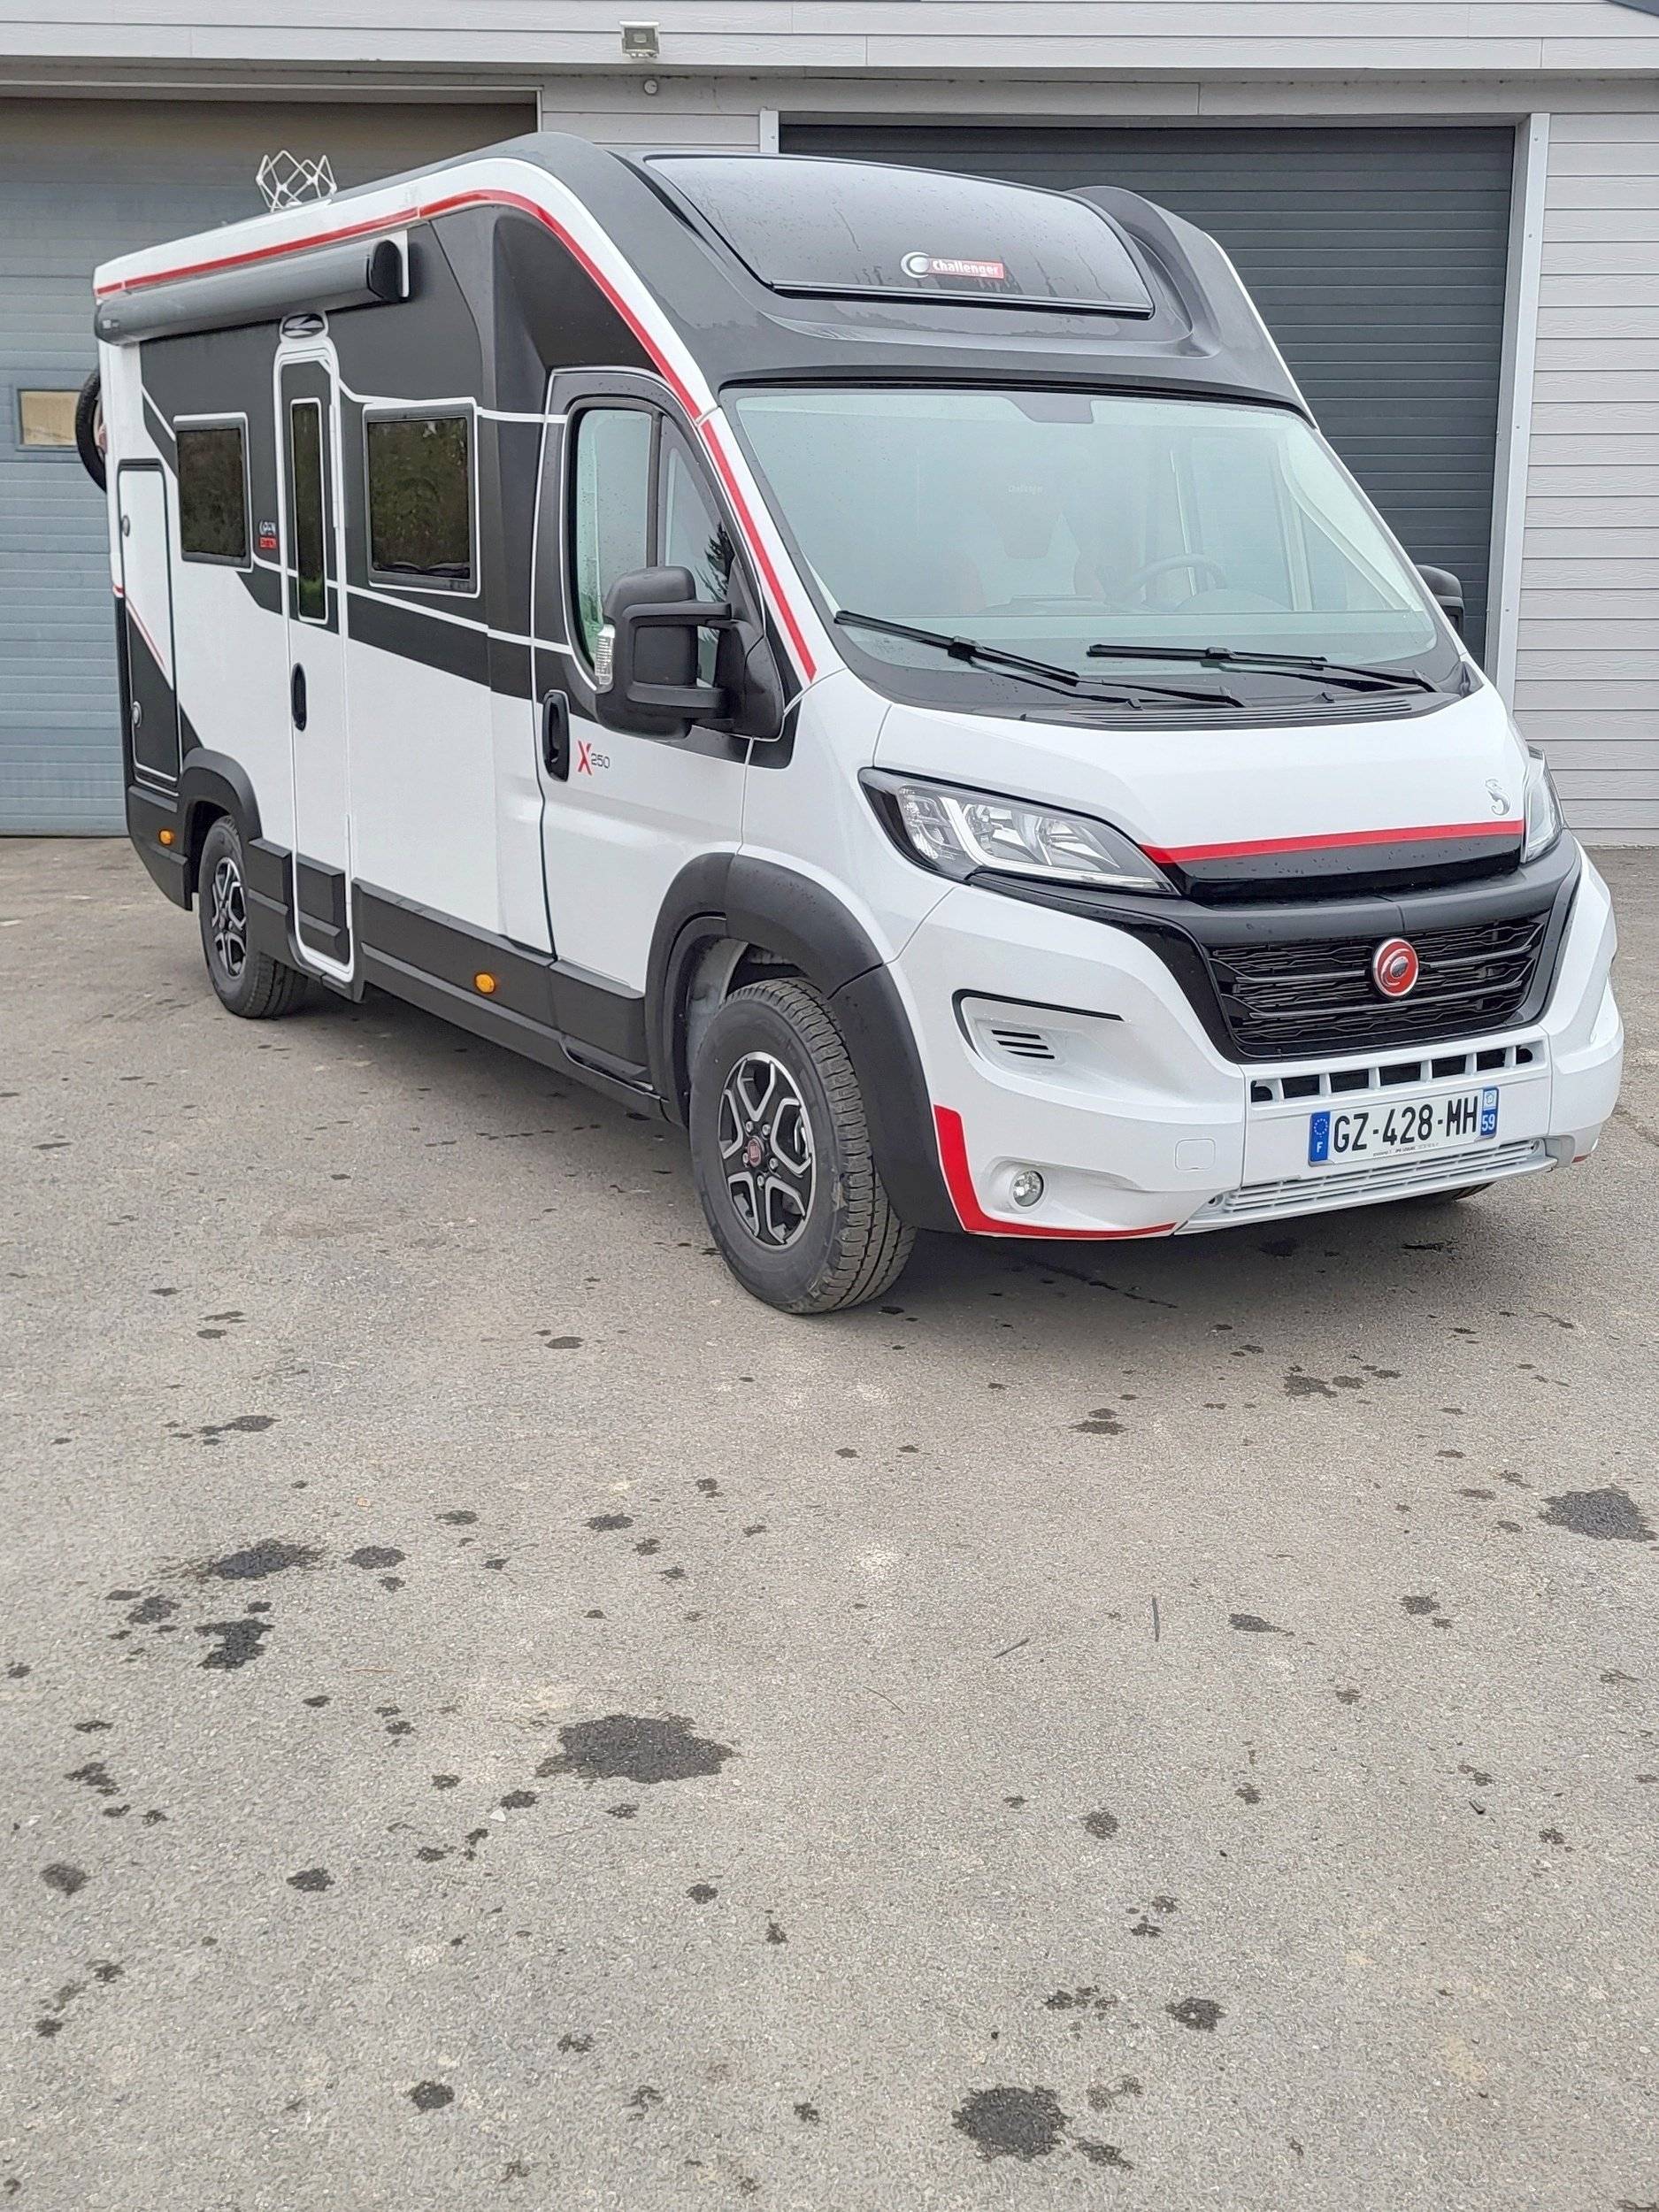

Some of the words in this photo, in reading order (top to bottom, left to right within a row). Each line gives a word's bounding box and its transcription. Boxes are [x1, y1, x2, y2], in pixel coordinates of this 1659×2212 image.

[932, 260, 999, 277] Challenger
[1333, 1095, 1479, 1153] GZ-428-MH
[1482, 1114, 1495, 1132] 59
[1316, 1141, 1324, 1153] F
